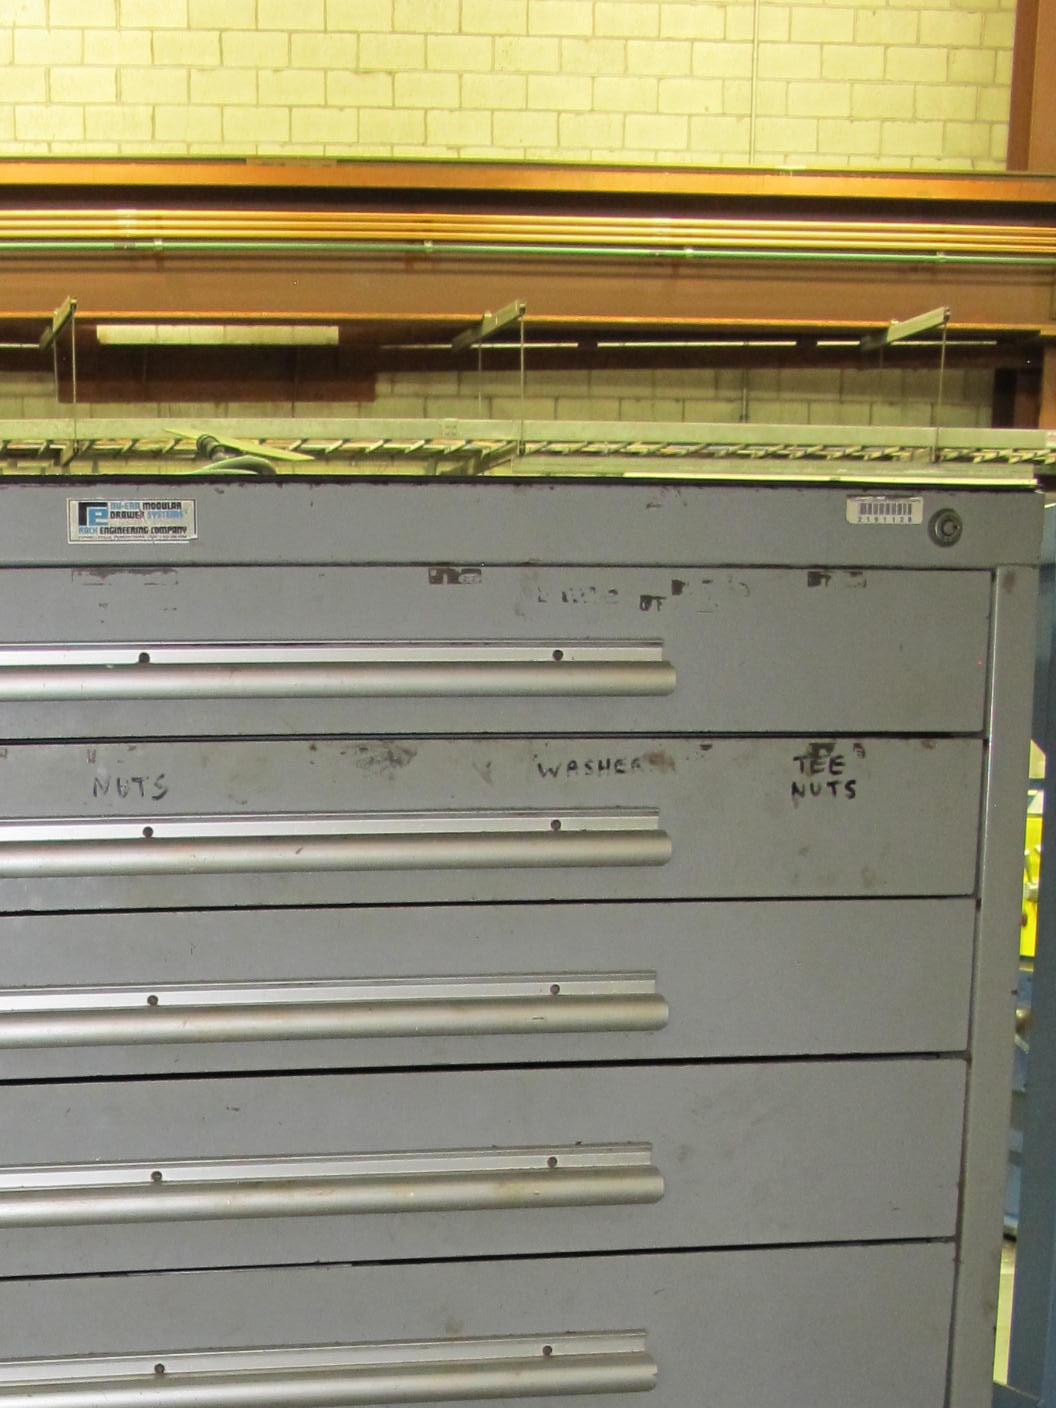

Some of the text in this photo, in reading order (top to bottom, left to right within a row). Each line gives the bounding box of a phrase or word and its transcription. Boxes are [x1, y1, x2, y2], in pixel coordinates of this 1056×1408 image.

[142, 502, 182, 511] MODULAR
[99, 526, 149, 535] ENGINEERING
[150, 526, 187, 535] COMPANY
[792, 754, 847, 777] TEE
[92, 773, 168, 801] NUTS
[791, 779, 857, 801] NUTS
